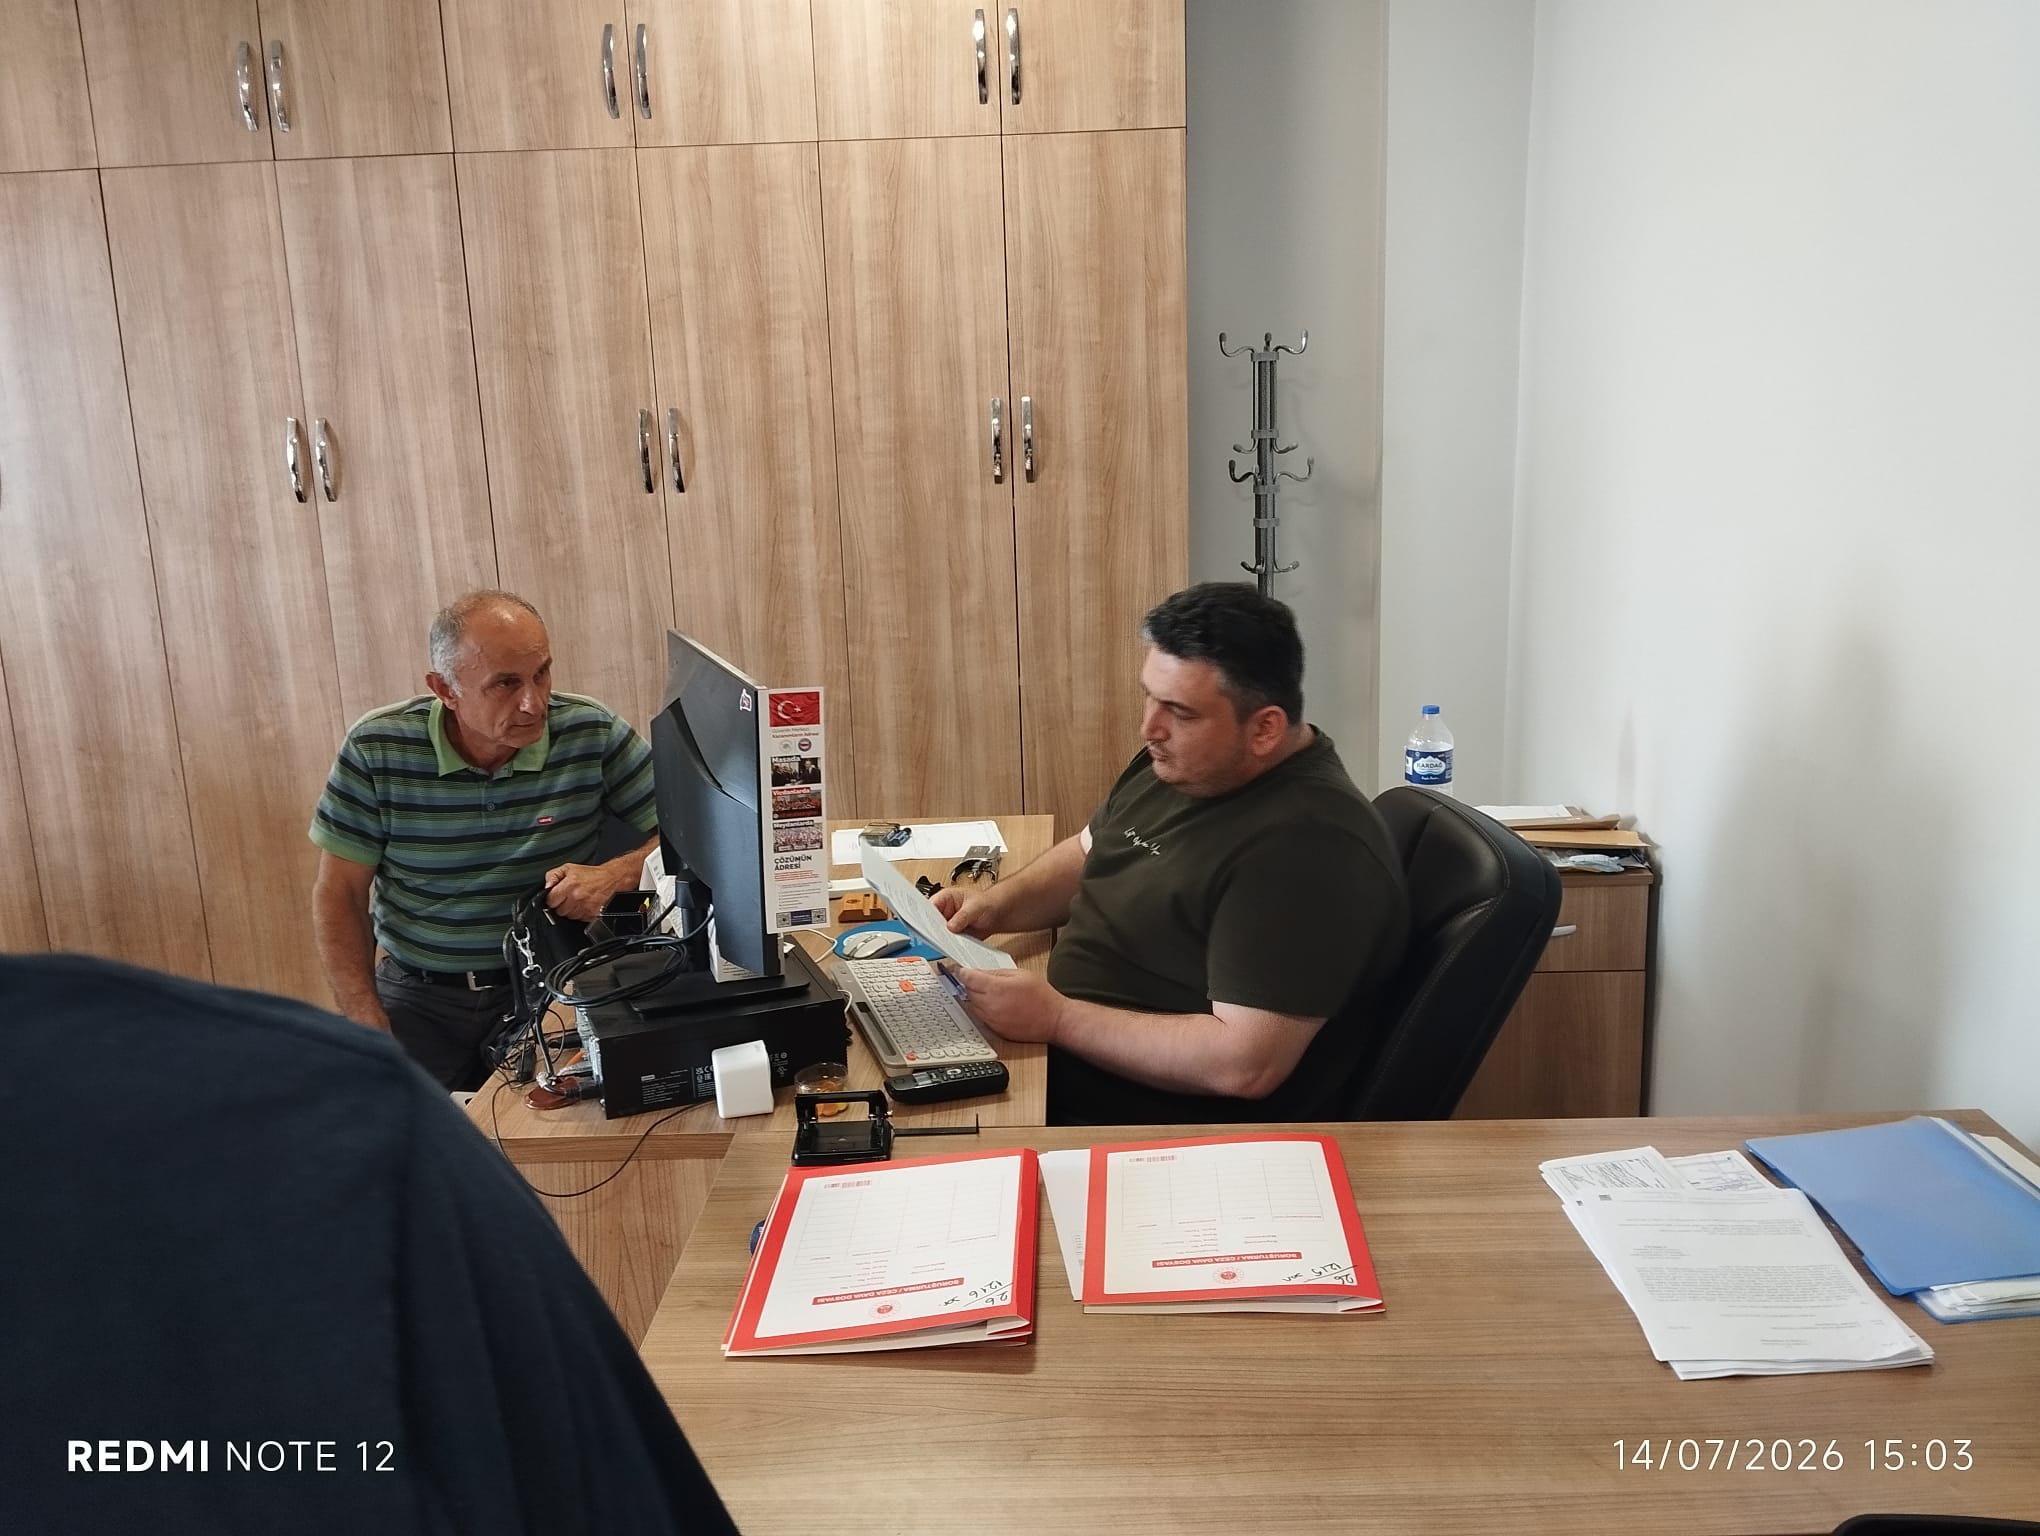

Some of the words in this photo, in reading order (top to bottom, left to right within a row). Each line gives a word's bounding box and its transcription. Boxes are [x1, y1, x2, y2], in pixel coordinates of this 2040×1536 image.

[1241, 1253, 1298, 1262] SORUŞTURMA
[1156, 1259, 1192, 1267] DOSYASI
[903, 1279, 960, 1293] SORUŞTURMA
[853, 1291, 875, 1299] DAVA
[875, 1288, 898, 1296] CEZA
[817, 1294, 853, 1303] DOSYASI
[984, 1290, 1009, 1306] 26
